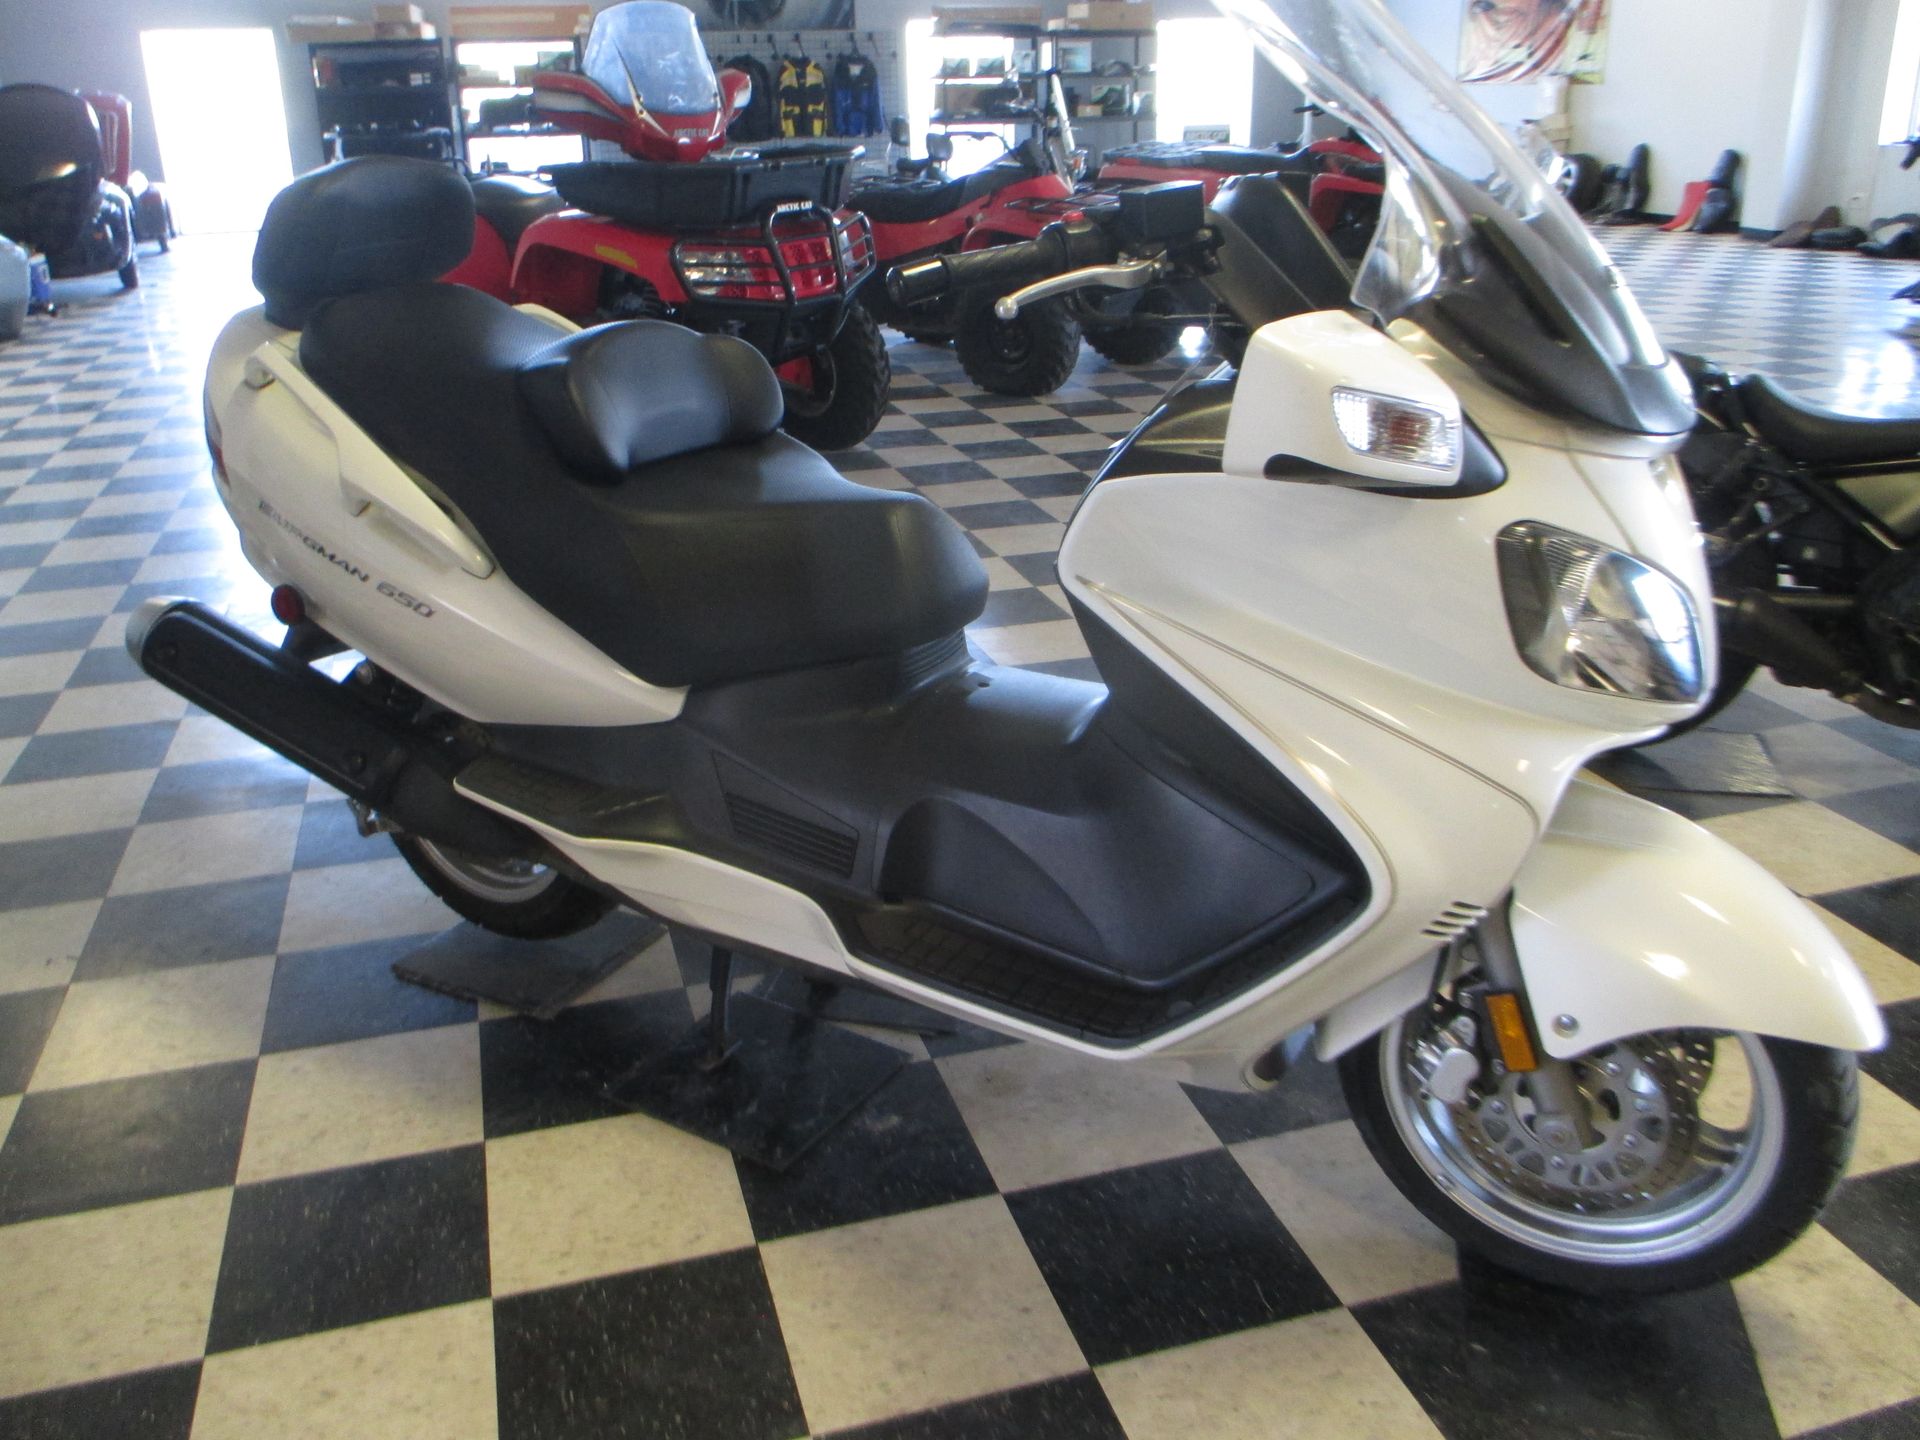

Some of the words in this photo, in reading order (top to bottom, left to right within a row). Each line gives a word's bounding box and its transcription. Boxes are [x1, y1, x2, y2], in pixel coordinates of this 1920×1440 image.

[777, 203, 800, 213] ARCTIC
[801, 200, 813, 210] CAT
[376, 581, 437, 618] 650
